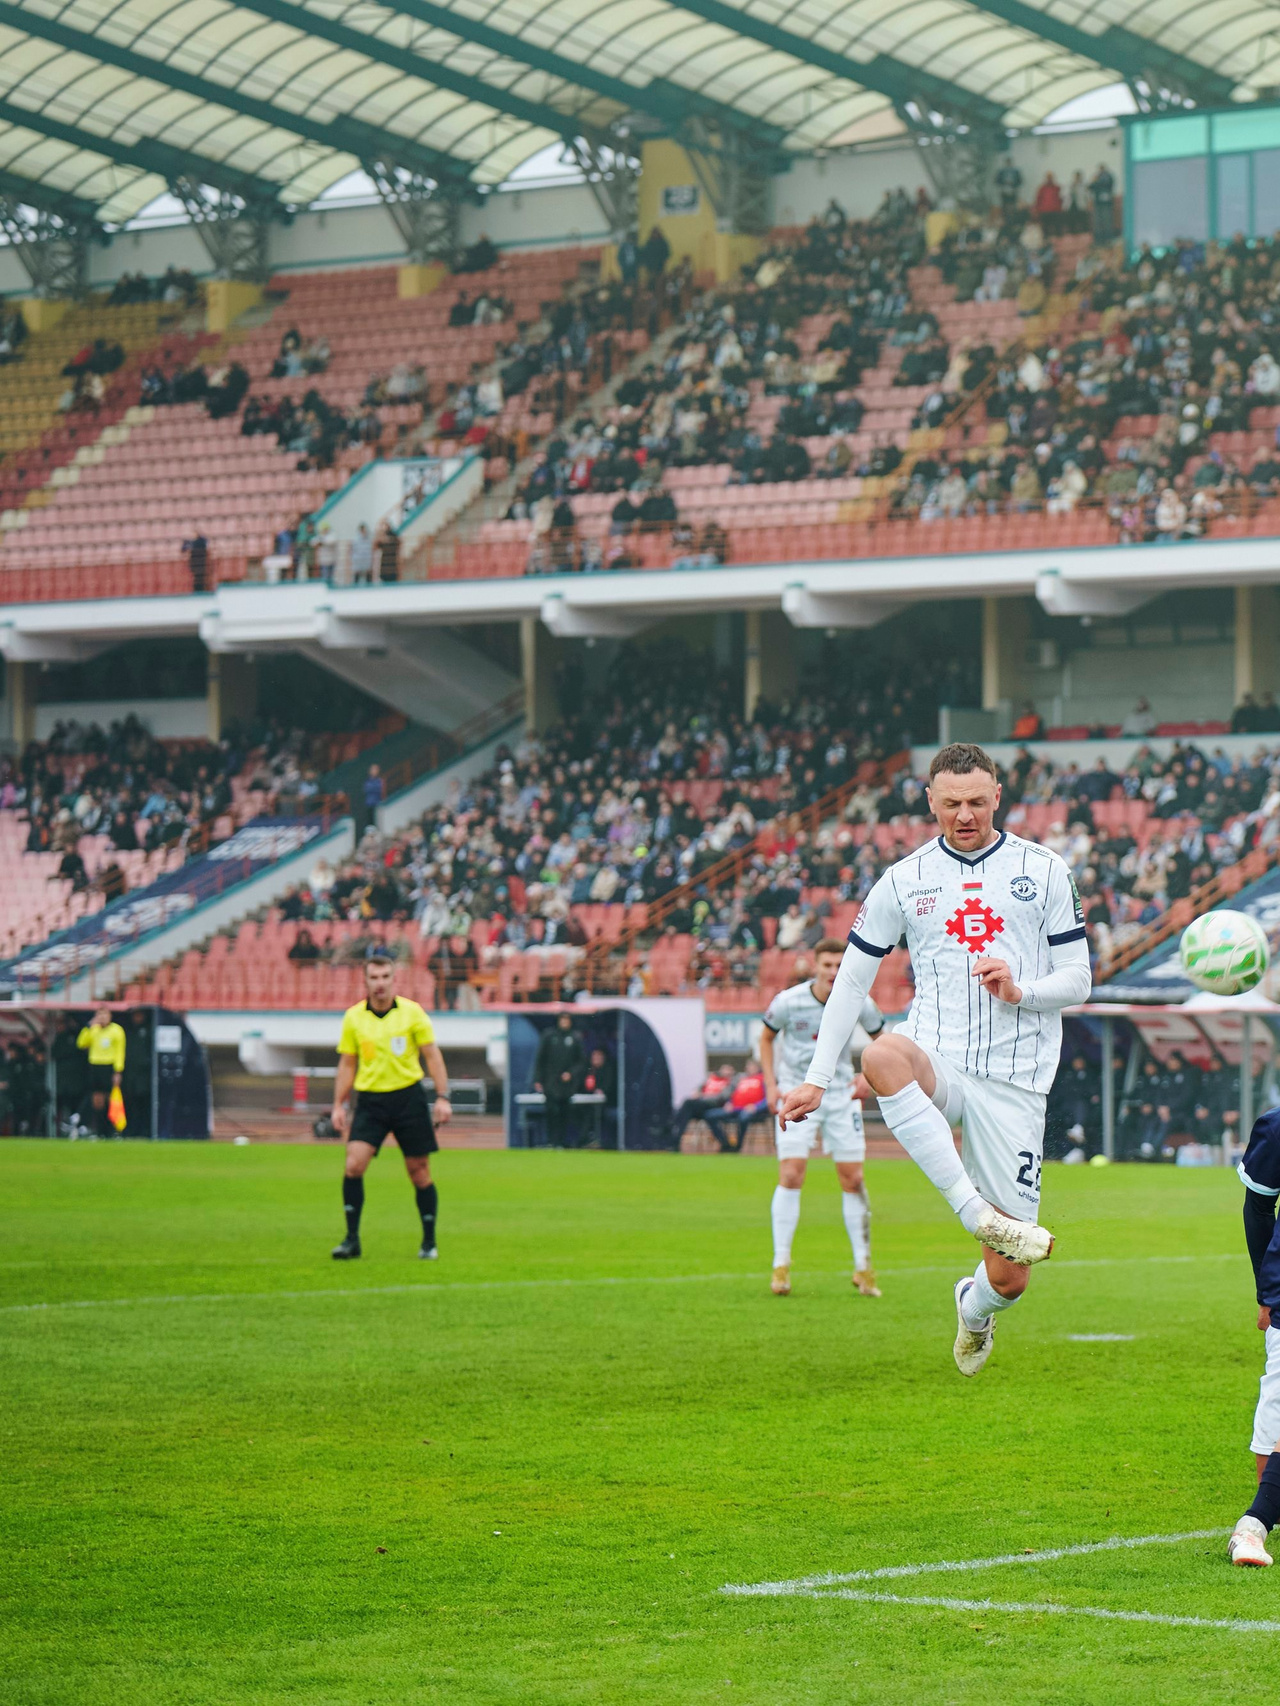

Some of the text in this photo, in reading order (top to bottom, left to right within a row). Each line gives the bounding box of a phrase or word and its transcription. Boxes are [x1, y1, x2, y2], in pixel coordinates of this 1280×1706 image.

[907, 886, 943, 898] uhlsport
[916, 896, 937, 907] FON
[916, 905, 936, 917] BET
